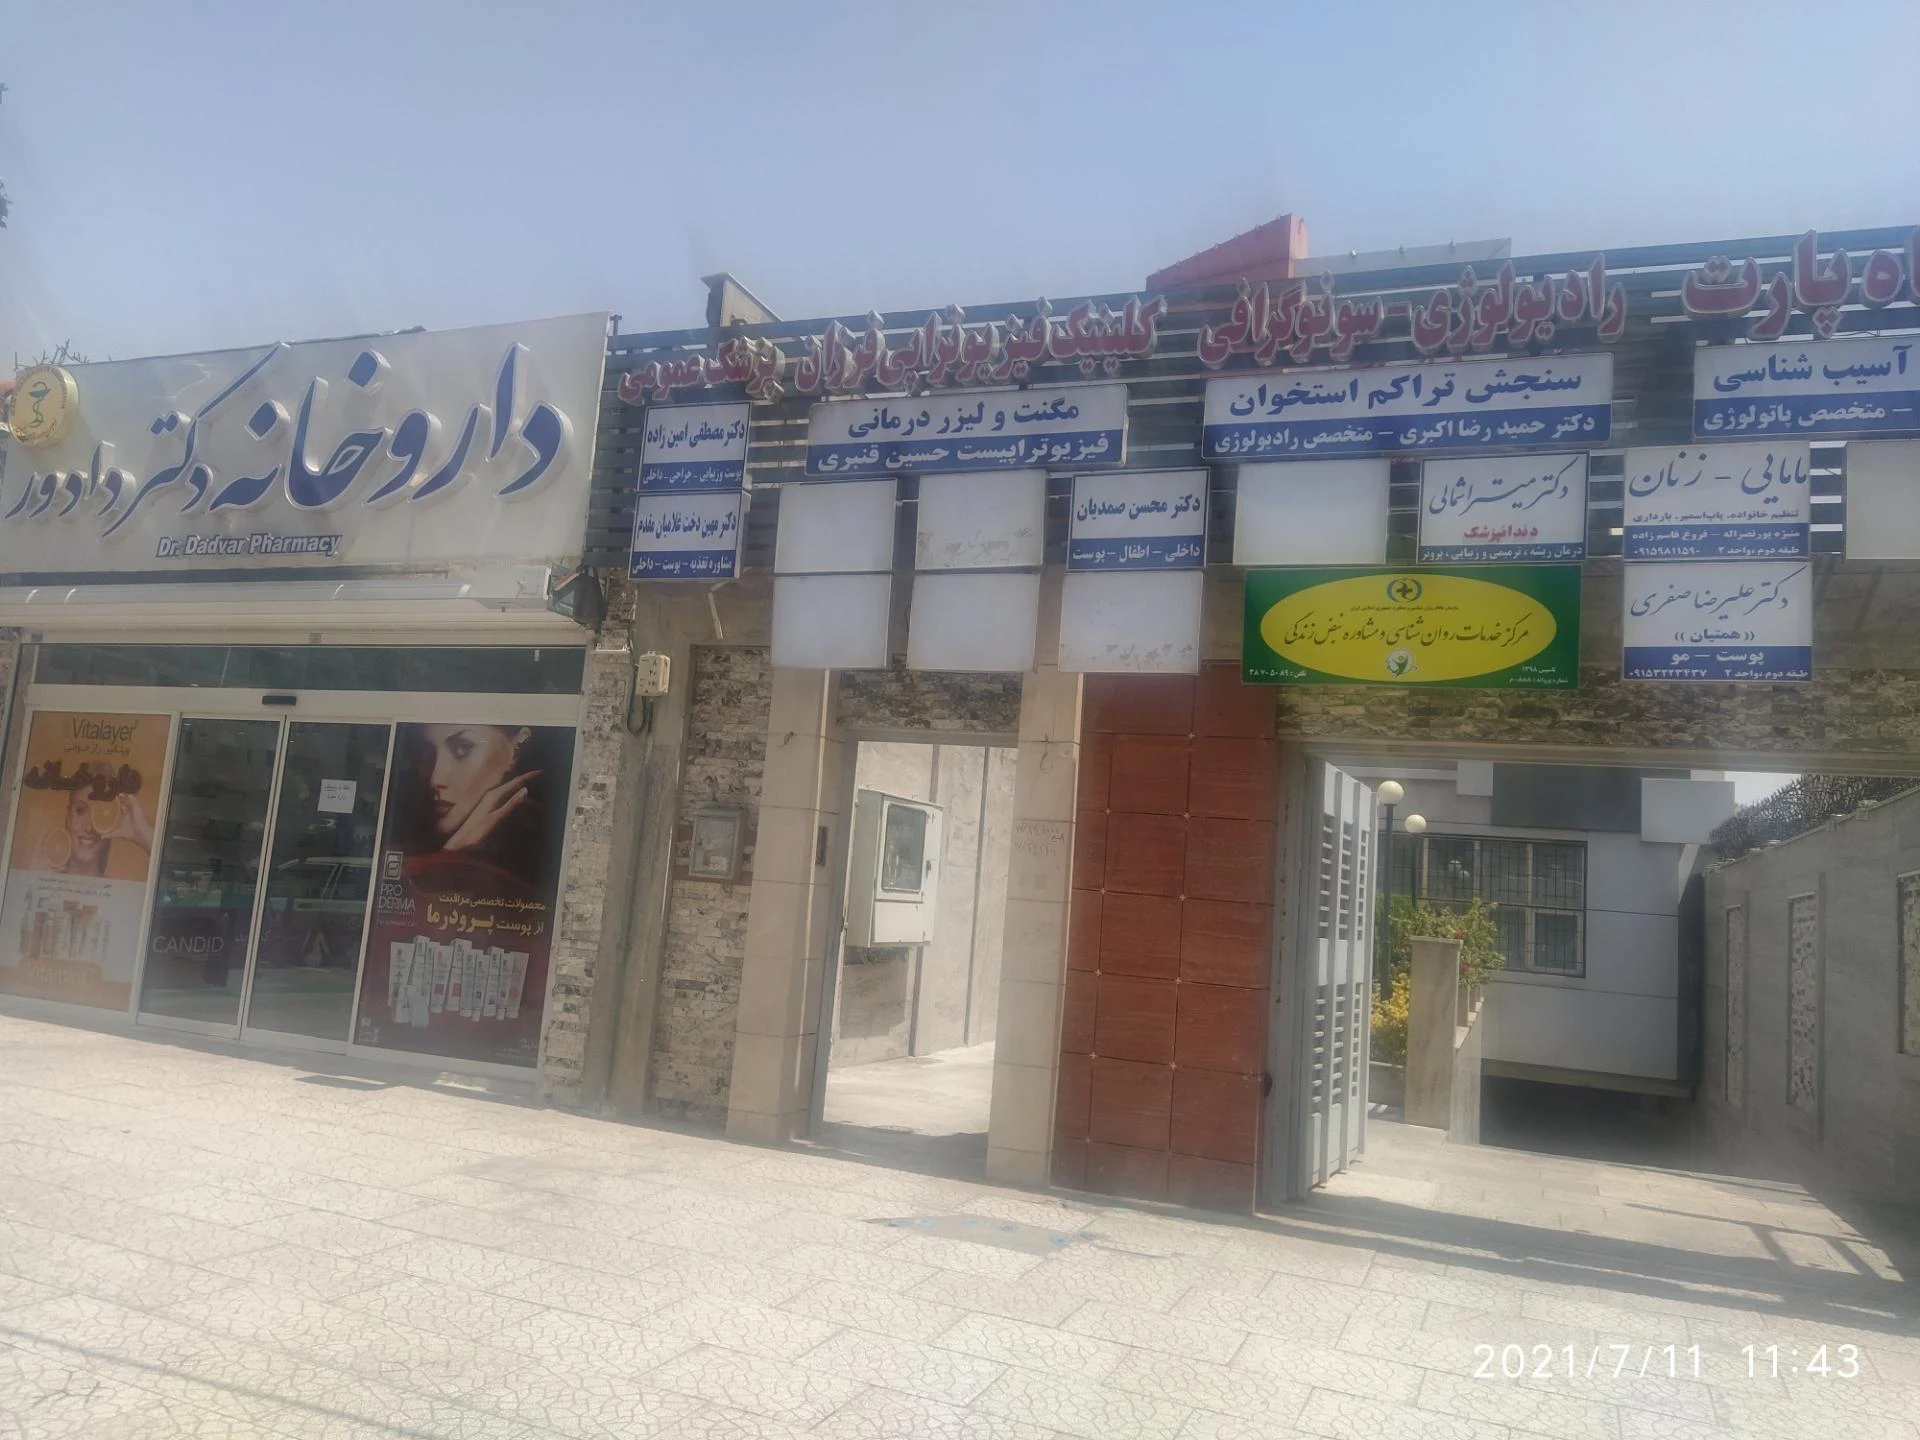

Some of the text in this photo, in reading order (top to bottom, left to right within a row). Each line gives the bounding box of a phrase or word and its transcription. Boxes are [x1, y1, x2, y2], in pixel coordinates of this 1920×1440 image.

[1681, 229, 1849, 341] پارت
[1198, 253, 1627, 369] رادیولوژی سونوگرافی
[876, 296, 1053, 396] فیزیوتراپی
[1050, 294, 1168, 379] کلینیک
[1713, 344, 1913, 393] آسیب شناسی
[1229, 368, 1582, 417] سنجش تراکم استخوان
[209, 342, 573, 512] داروخانه
[848, 407, 931, 438] درمانی
[937, 400, 985, 434] لیزر
[991, 410, 1006, 431] و
[1703, 401, 1886, 431] متخصص پاتولوژی
[102, 342, 291, 538] دکتر
[647, 419, 746, 450] دکتر مصطفی امین زاده
[1214, 413, 1596, 453] دکتر حمید رضا اکبری متخصص رادیولوژی
[818, 433, 1109, 473] فیزیوتراپیست حسین قنبری
[4, 440, 136, 520] دادور
[642, 468, 663, 485] داخلی
[1522, 456, 1580, 511] دکتر
[1627, 451, 1808, 505] مامایی زنان
[1077, 493, 1201, 521] دکتر محسن صمدیان
[1632, 511, 1672, 524] بارداری
[1770, 509, 1800, 521] تنظیم
[718, 511, 737, 538] دکتر
[1681, 530, 1709, 542] فروغ
[157, 533, 344, 558] Dr. Dadvar Pharmacy
[1072, 541, 1201, 563] داخلی اطفال پوست
[1553, 545, 1583, 559] درمان
[1758, 548, 1776, 556] دوم
[631, 555, 732, 575] مشاوره تغذیه پوست داخلی
[1630, 565, 1808, 620] دکتر علیرضا صفری
[1283, 610, 1316, 645] زندگی
[1313, 612, 1344, 645] نبض
[1342, 616, 1380, 641] مشاوره
[1386, 615, 1424, 646] شناسی
[1420, 625, 1455, 647] روان
[1455, 621, 1503, 642] خدمات
[1500, 611, 1533, 648] مرکز
[1671, 650, 1764, 666] پوست مو
[1765, 671, 1784, 680] دوم
[72, 718, 135, 744] Vitalayer
[380, 883, 403, 897] PRO
[470, 895, 505, 909] تخصصی
[377, 896, 416, 912] DERMA
[505, 898, 546, 911] محصولات
[426, 903, 494, 934] پرودرما
[496, 920, 532, 936] پوست
[534, 921, 545, 934] از
[152, 935, 224, 953] CANDID
